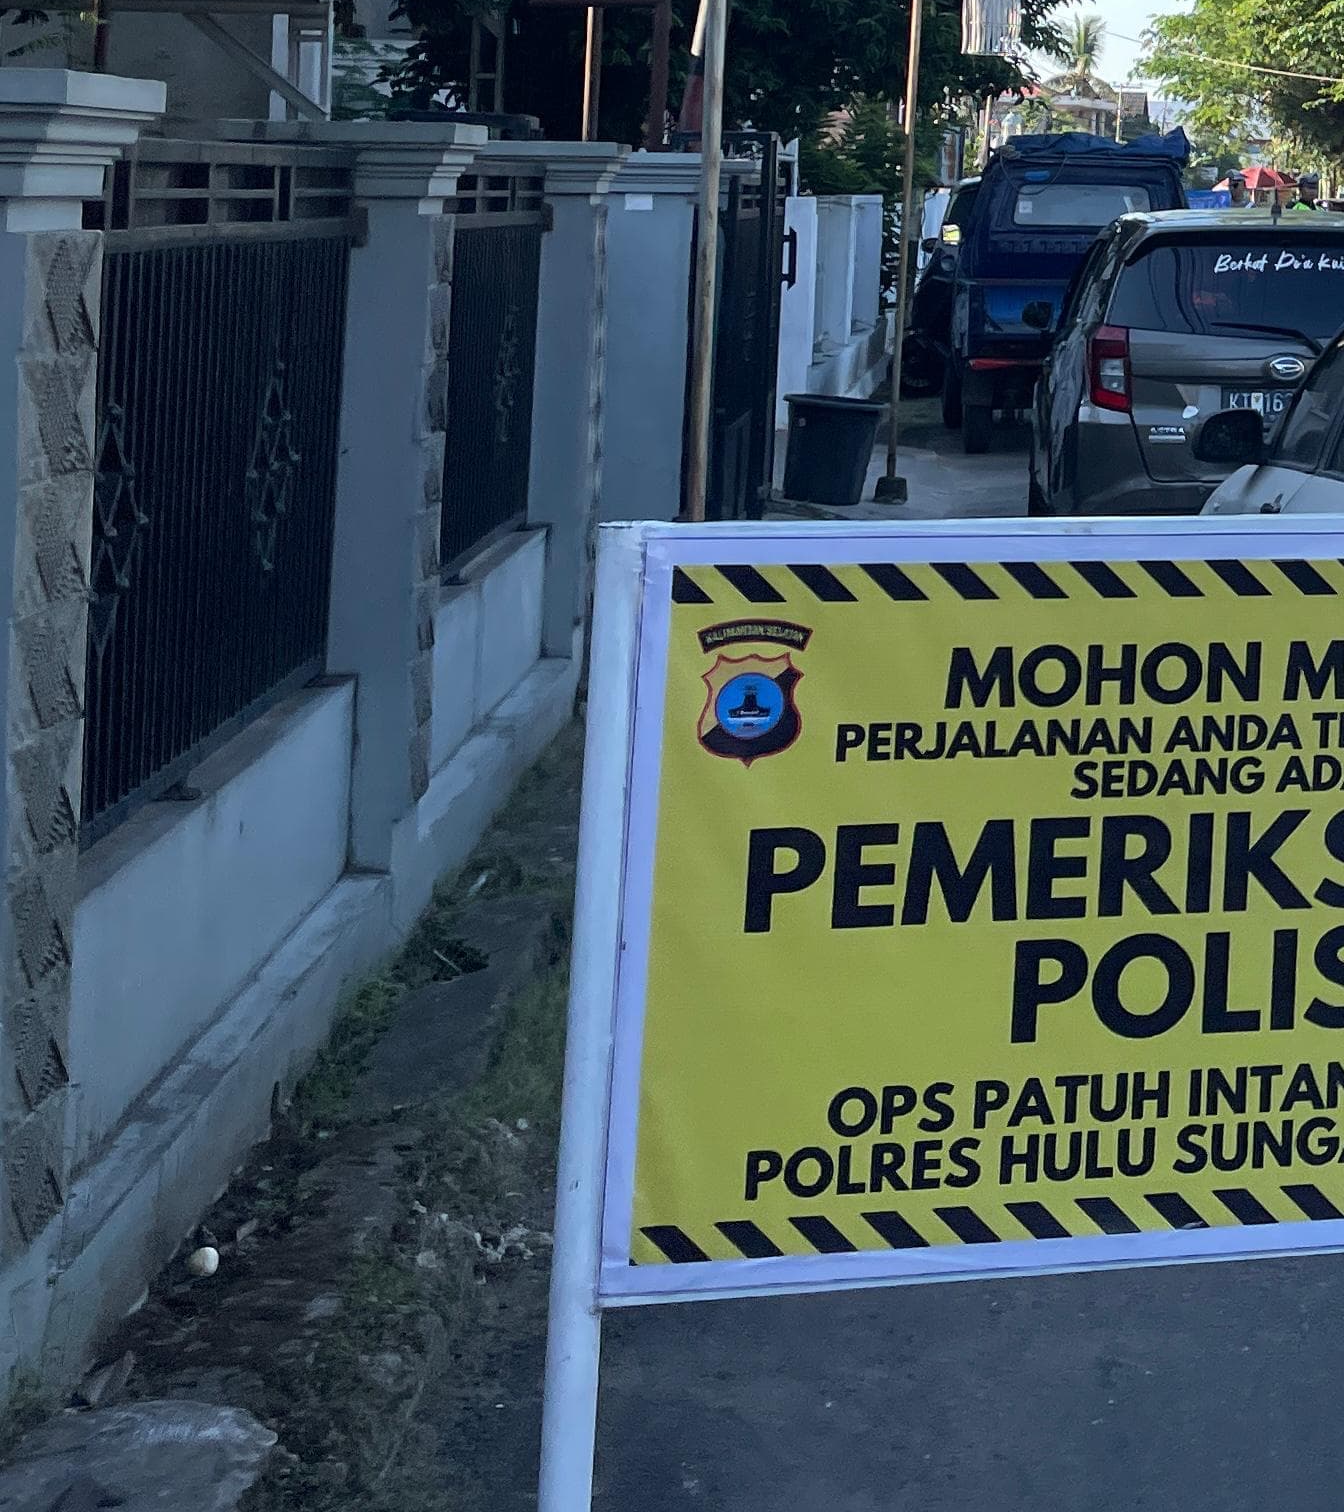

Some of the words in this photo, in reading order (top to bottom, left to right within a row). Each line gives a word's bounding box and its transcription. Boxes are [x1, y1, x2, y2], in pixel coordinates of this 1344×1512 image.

[1214, 252, 1268, 273] Berkat
[1264, 392, 1294, 413] 16
[944, 641, 1262, 710] MOHON
[836, 717, 1154, 763] PERJALANAN
[1164, 713, 1303, 754] ANDA
[1070, 755, 1266, 800] SEDANG
[827, 1082, 955, 1138] OPS
[973, 1070, 1171, 1130] PATUH
[744, 1137, 981, 1201] POLRES
[999, 1126, 1157, 1186] HULU
